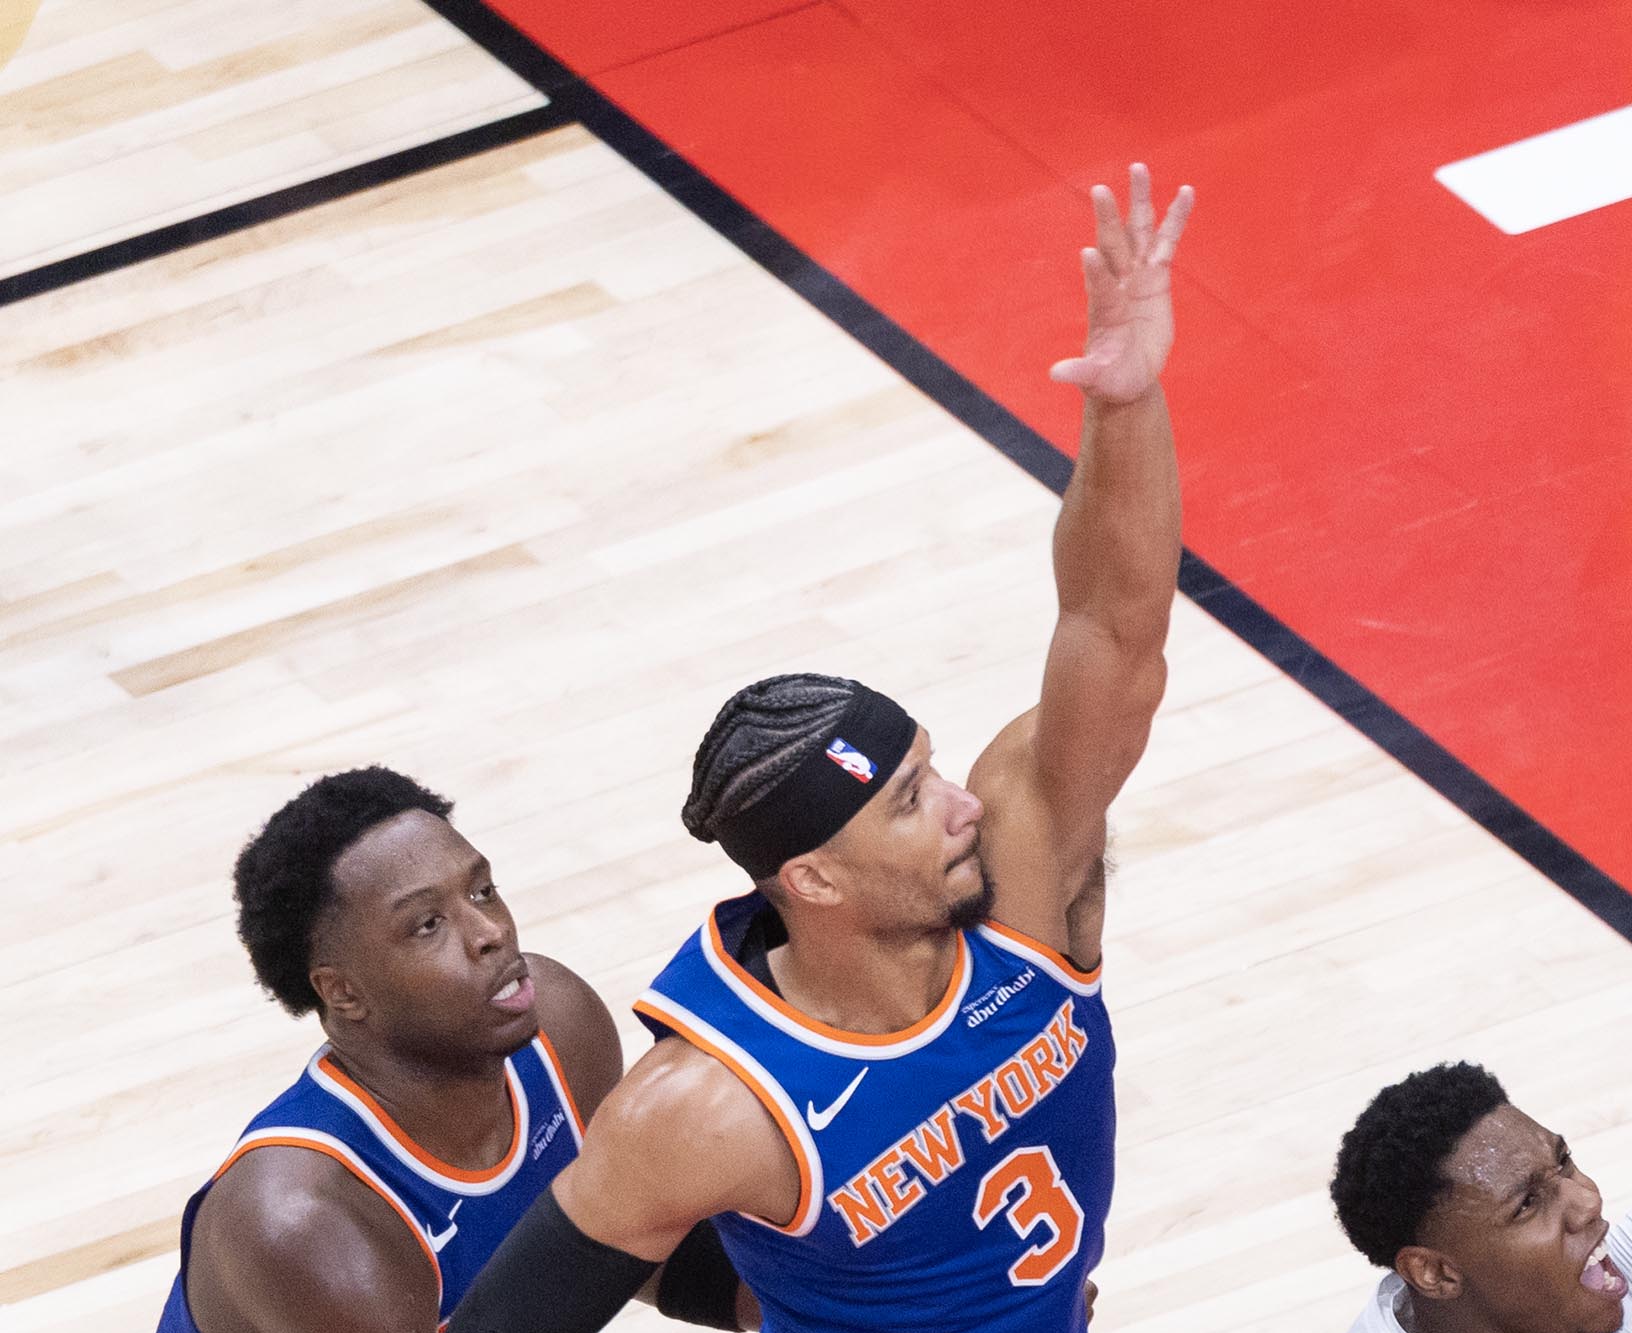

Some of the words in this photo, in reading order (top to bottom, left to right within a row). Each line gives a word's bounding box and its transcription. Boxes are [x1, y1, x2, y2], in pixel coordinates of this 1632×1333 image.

[967, 1002, 998, 1028] abu
[995, 966, 1036, 1006] dhabi
[827, 1101, 965, 1248] NEW
[950, 996, 1088, 1144] YORK
[971, 1145, 1085, 1286] 3
